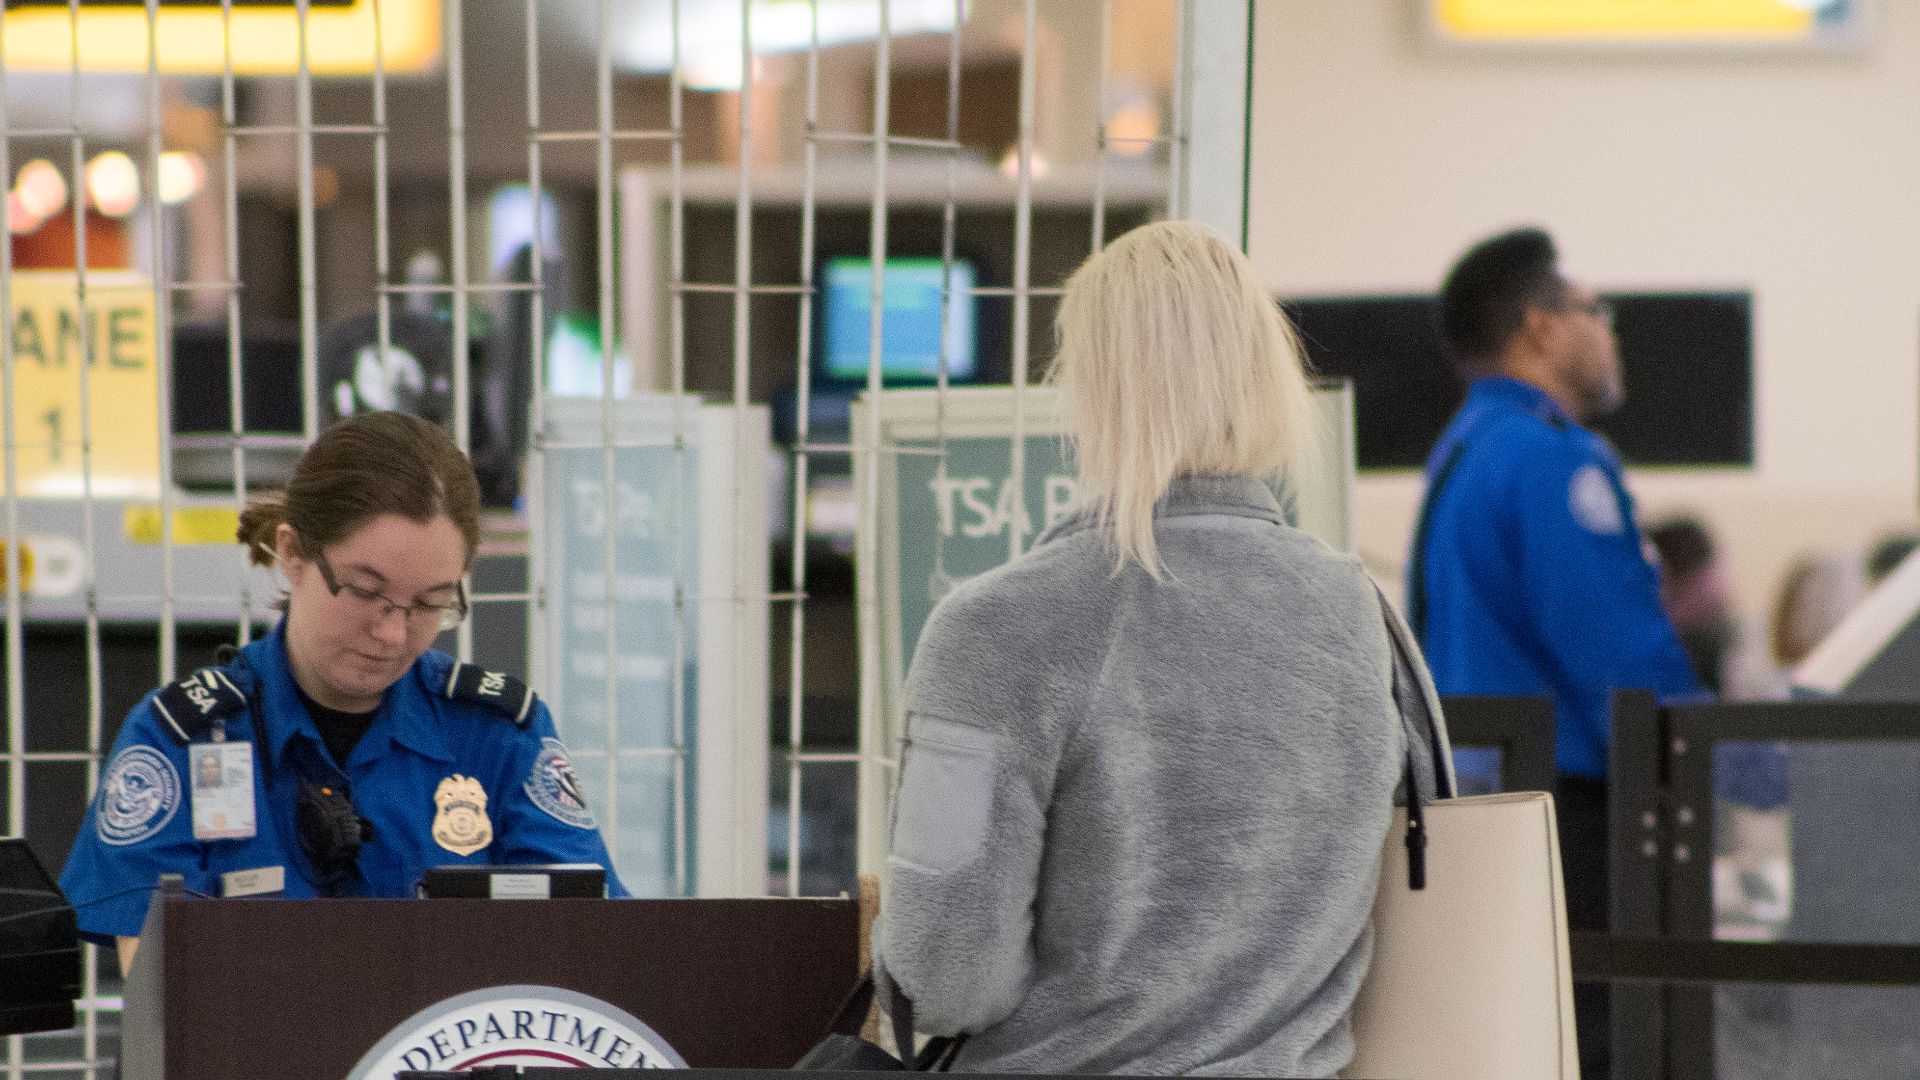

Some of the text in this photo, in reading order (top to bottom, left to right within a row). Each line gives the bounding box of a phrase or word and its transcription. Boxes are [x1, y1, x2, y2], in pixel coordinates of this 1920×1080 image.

[0, 307, 148, 370] ANE
[929, 475, 1033, 537] TSA
[180, 674, 218, 714] TSA
[478, 670, 506, 696] TSA
